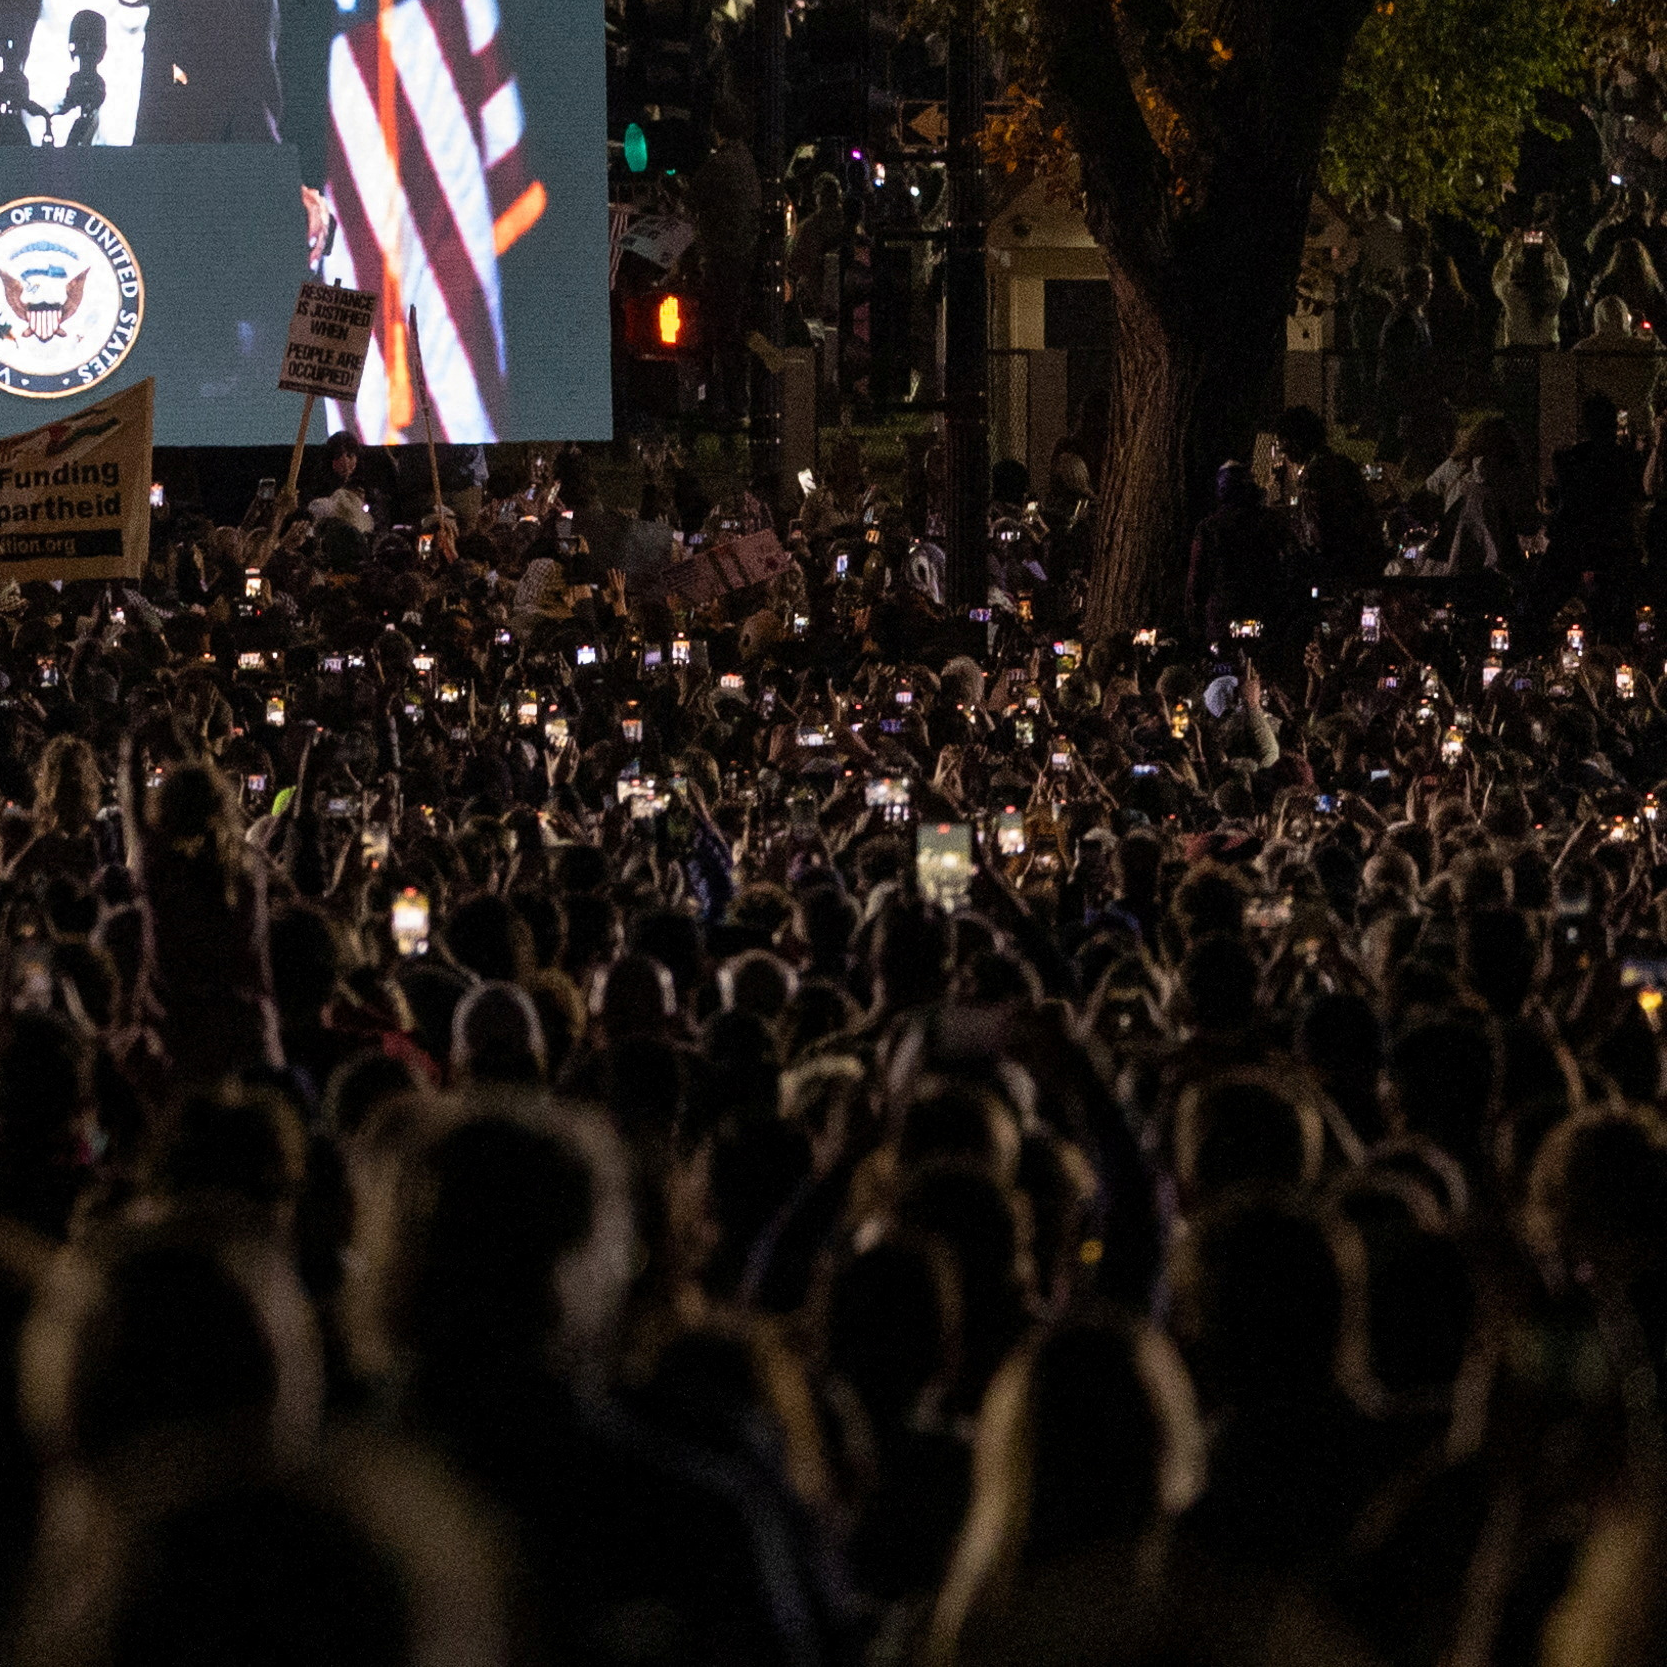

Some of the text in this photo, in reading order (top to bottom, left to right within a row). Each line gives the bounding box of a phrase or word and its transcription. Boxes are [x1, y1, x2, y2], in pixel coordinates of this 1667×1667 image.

[10, 207, 34, 224] OF
[41, 206, 77, 226] THE
[84, 215, 138, 298] UNITED
[300, 284, 376, 312] RESISTANCE
[296, 300, 371, 327] IS JUSTIFIED
[310, 320, 349, 340] WHEN
[78, 309, 137, 384] STATES
[287, 342, 362, 370] PEOPLE ARE
[288, 360, 355, 387] OCCUPIED!
